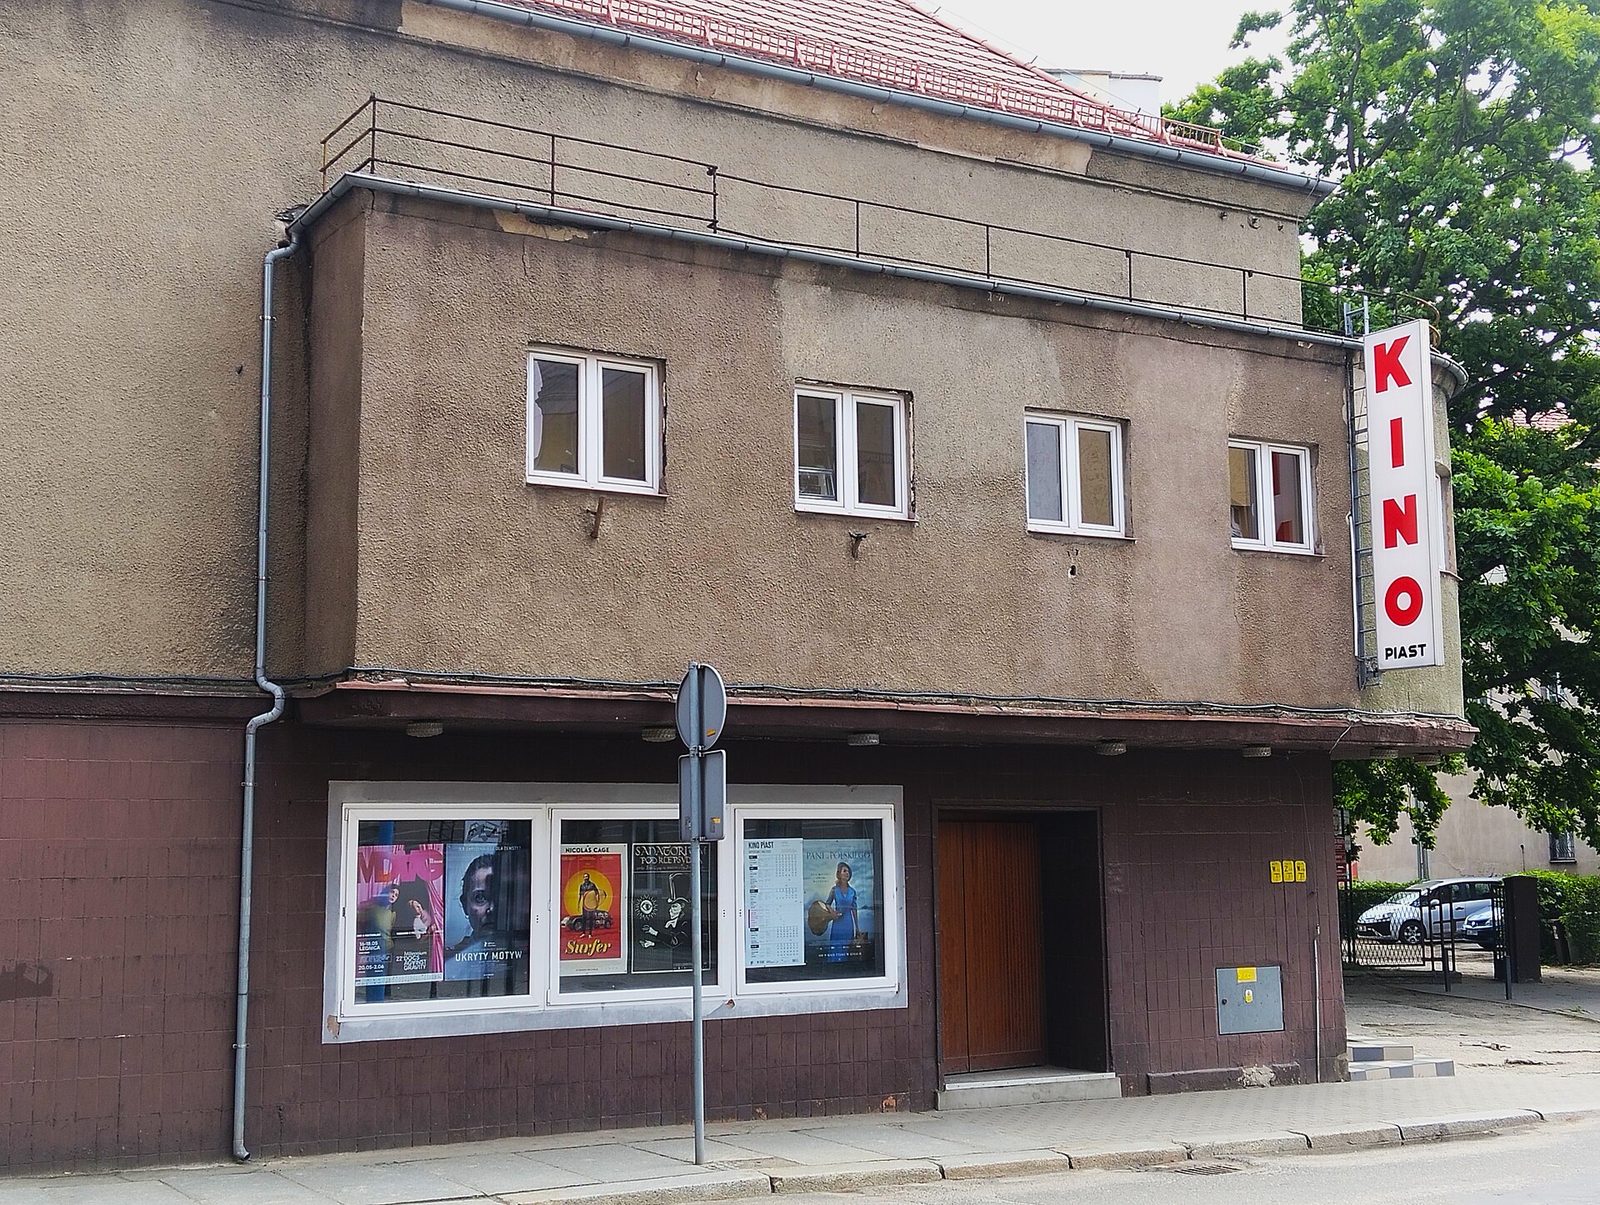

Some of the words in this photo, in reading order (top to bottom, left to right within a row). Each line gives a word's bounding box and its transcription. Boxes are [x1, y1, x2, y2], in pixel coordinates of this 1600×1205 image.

[1373, 335, 1424, 627] KINO
[1385, 644, 1427, 660] PIAST
[635, 845, 707, 857] SANATORI
[565, 937, 612, 957] Surfer
[455, 952, 489, 962] UKRYTY
[491, 951, 523, 960] MOTYW
